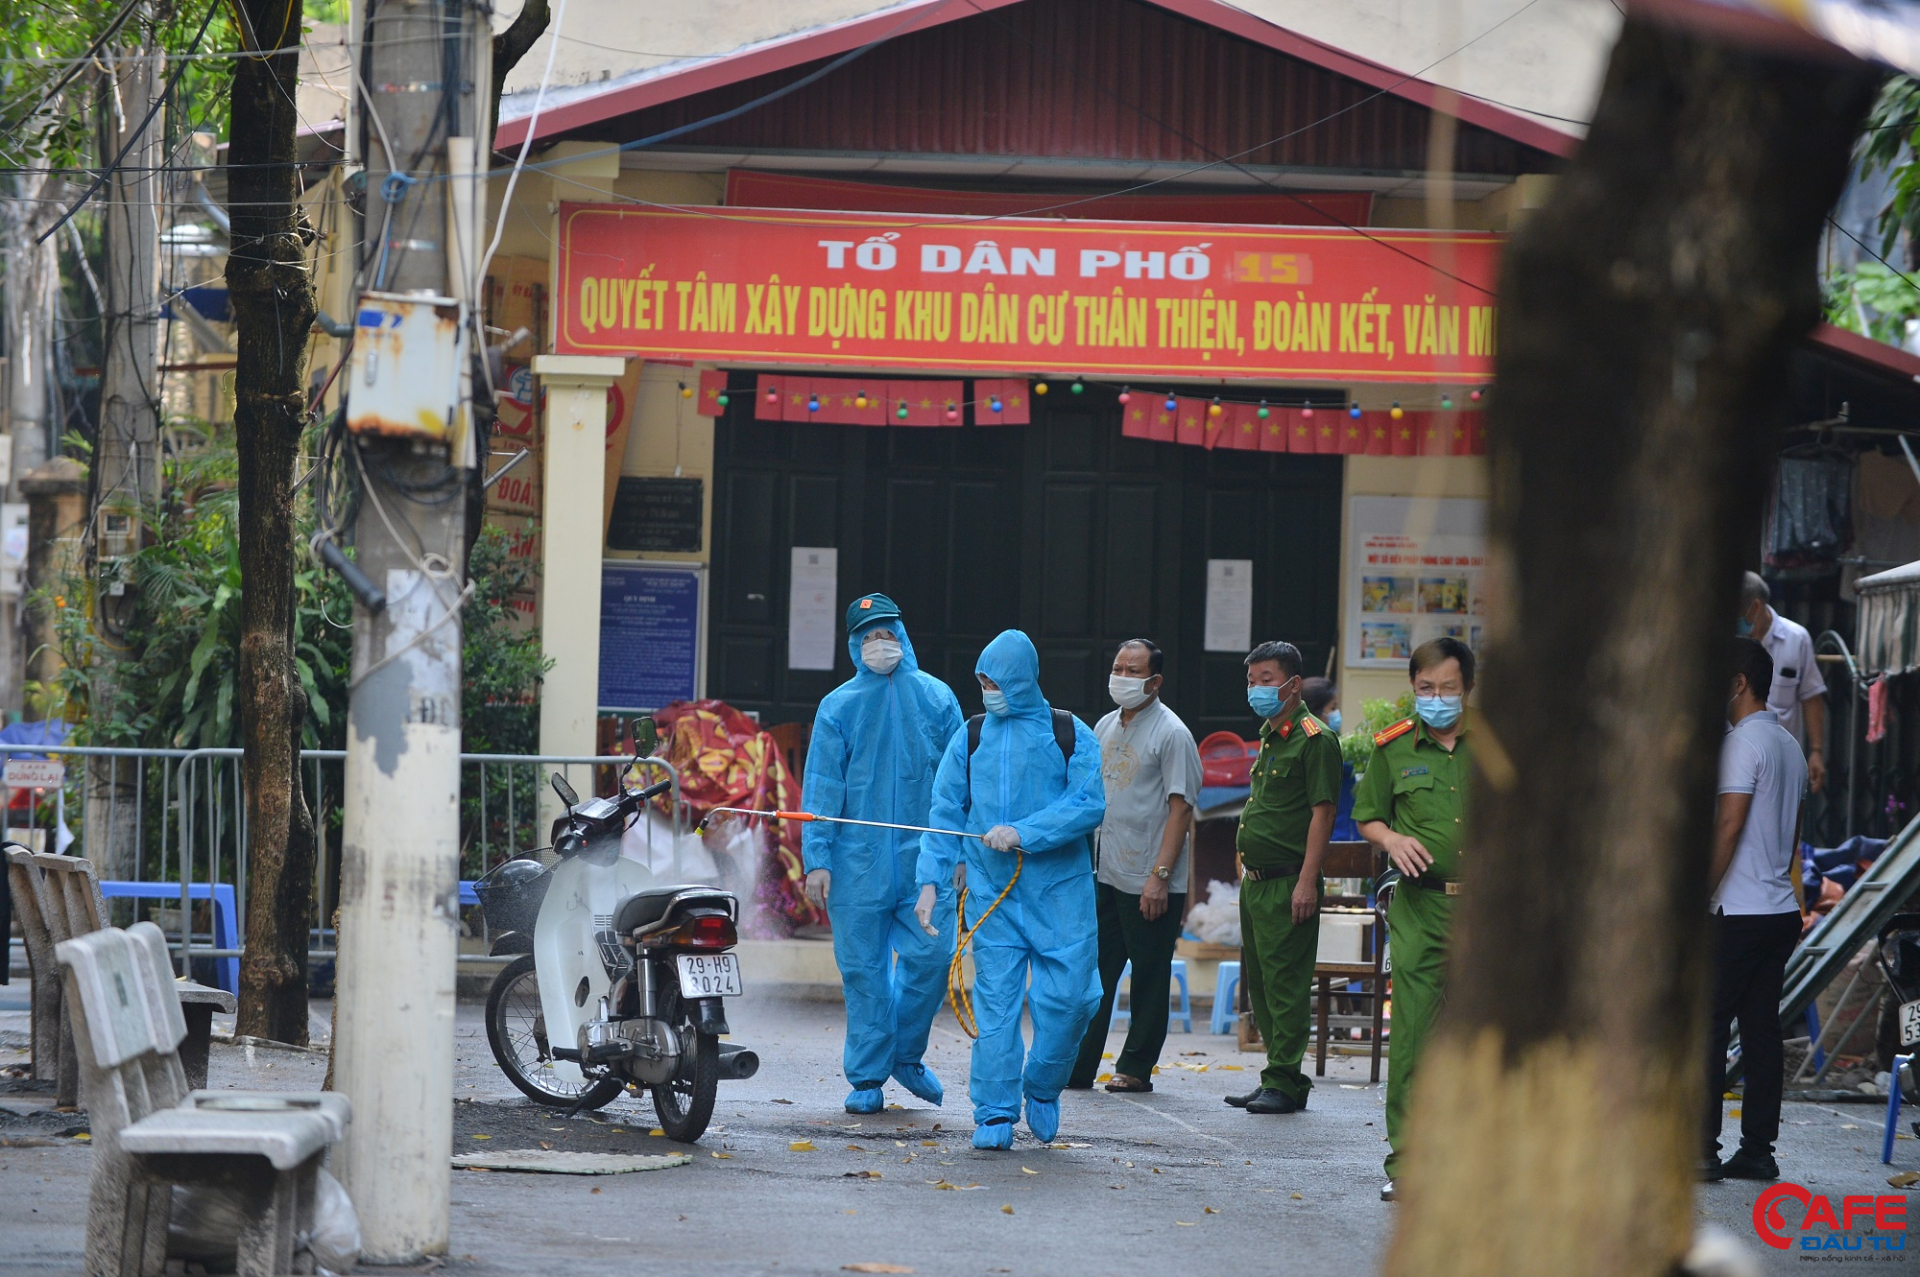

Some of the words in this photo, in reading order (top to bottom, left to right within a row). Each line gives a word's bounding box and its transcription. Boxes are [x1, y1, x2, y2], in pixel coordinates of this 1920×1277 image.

[818, 231, 902, 272] TỔ
[920, 239, 1057, 278] DÂN
[1079, 243, 1213, 282] PHỐ
[1239, 254, 1299, 283] 15
[580, 262, 669, 334] QUYẾT
[676, 271, 737, 333] TÂM
[744, 273, 801, 336] XÂY
[808, 282, 887, 349] DỰNG
[895, 290, 952, 342] KHU
[960, 282, 1019, 344] DÂN
[1027, 290, 1070, 346] CƯ
[1074, 286, 1148, 347] THÂN
[1156, 288, 1245, 361] THIỆN,
[1252, 291, 1331, 352] ĐOÀN
[1339, 287, 1394, 360] KẾT,
[1403, 294, 1460, 355] VĂN
[497, 475, 535, 507] ĐOÀ
[686, 956, 731, 974] 29-H9
